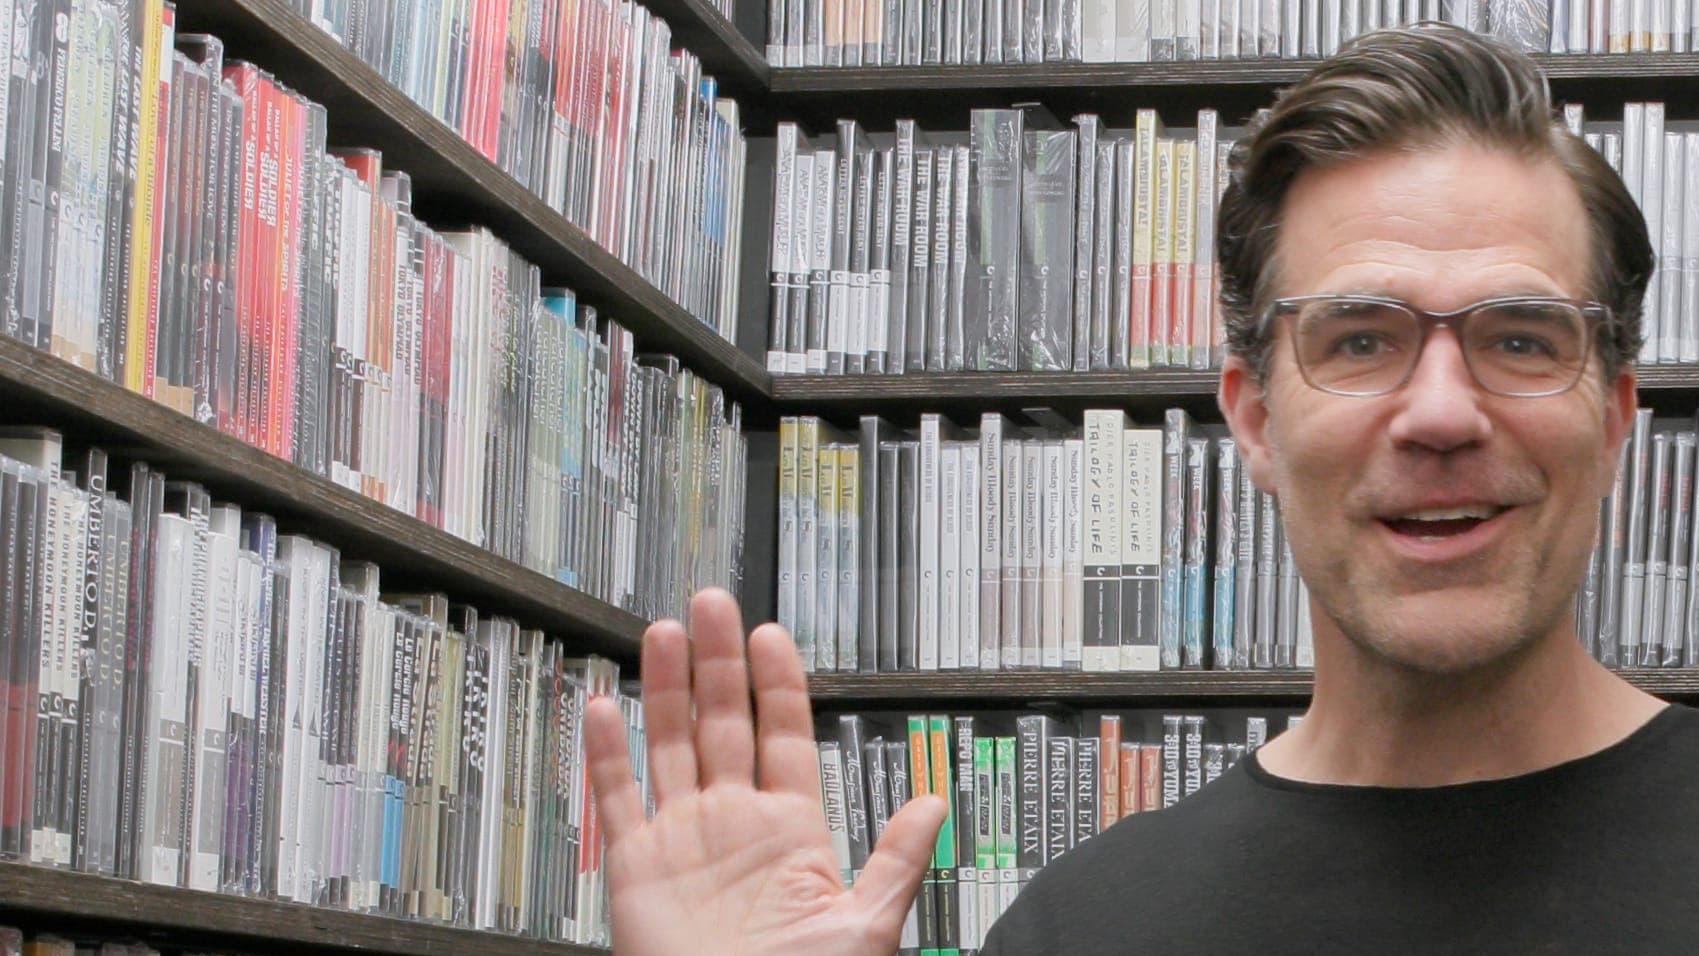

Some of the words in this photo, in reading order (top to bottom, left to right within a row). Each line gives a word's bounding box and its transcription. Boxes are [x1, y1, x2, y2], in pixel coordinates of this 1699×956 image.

[54, 48, 66, 105] FEDERICO
[130, 76, 142, 119] LAST
[52, 108, 64, 153] FELLINI
[128, 126, 140, 182] WAVE
[915, 159, 927, 185] THE
[936, 156, 948, 182] THE
[914, 191, 927, 220] WAR
[935, 188, 948, 218] WAR
[913, 226, 926, 268] ROOM
[934, 223, 947, 265] ROOM
[986, 433, 998, 473] Sunday
[1088, 422, 1100, 489] TRILOGY
[1127, 441, 1139, 497] TRILOGY
[1024, 457, 1036, 490] Sunday
[986, 475, 998, 512] Bloody
[1024, 492, 1036, 525] Bloody
[1091, 495, 1102, 514] OF
[1129, 503, 1141, 519] OF
[44, 498, 57, 594] HONEYMOON
[84, 475, 103, 603] UMBERTO
[986, 514, 998, 553] Sunday
[1024, 526, 1036, 560] Sunday
[1090, 520, 1102, 556] LIFE
[1129, 524, 1141, 553] LIFE
[41, 603, 53, 669] KILLERS
[82, 611, 97, 631] D.
[958, 729, 972, 762] REPO
[1022, 732, 1040, 794] PIERRE
[1163, 735, 1179, 760] 3:10
[959, 764, 972, 792] MAN
[1050, 741, 1066, 803] PIERRE
[822, 763, 844, 833] BADLANDS
